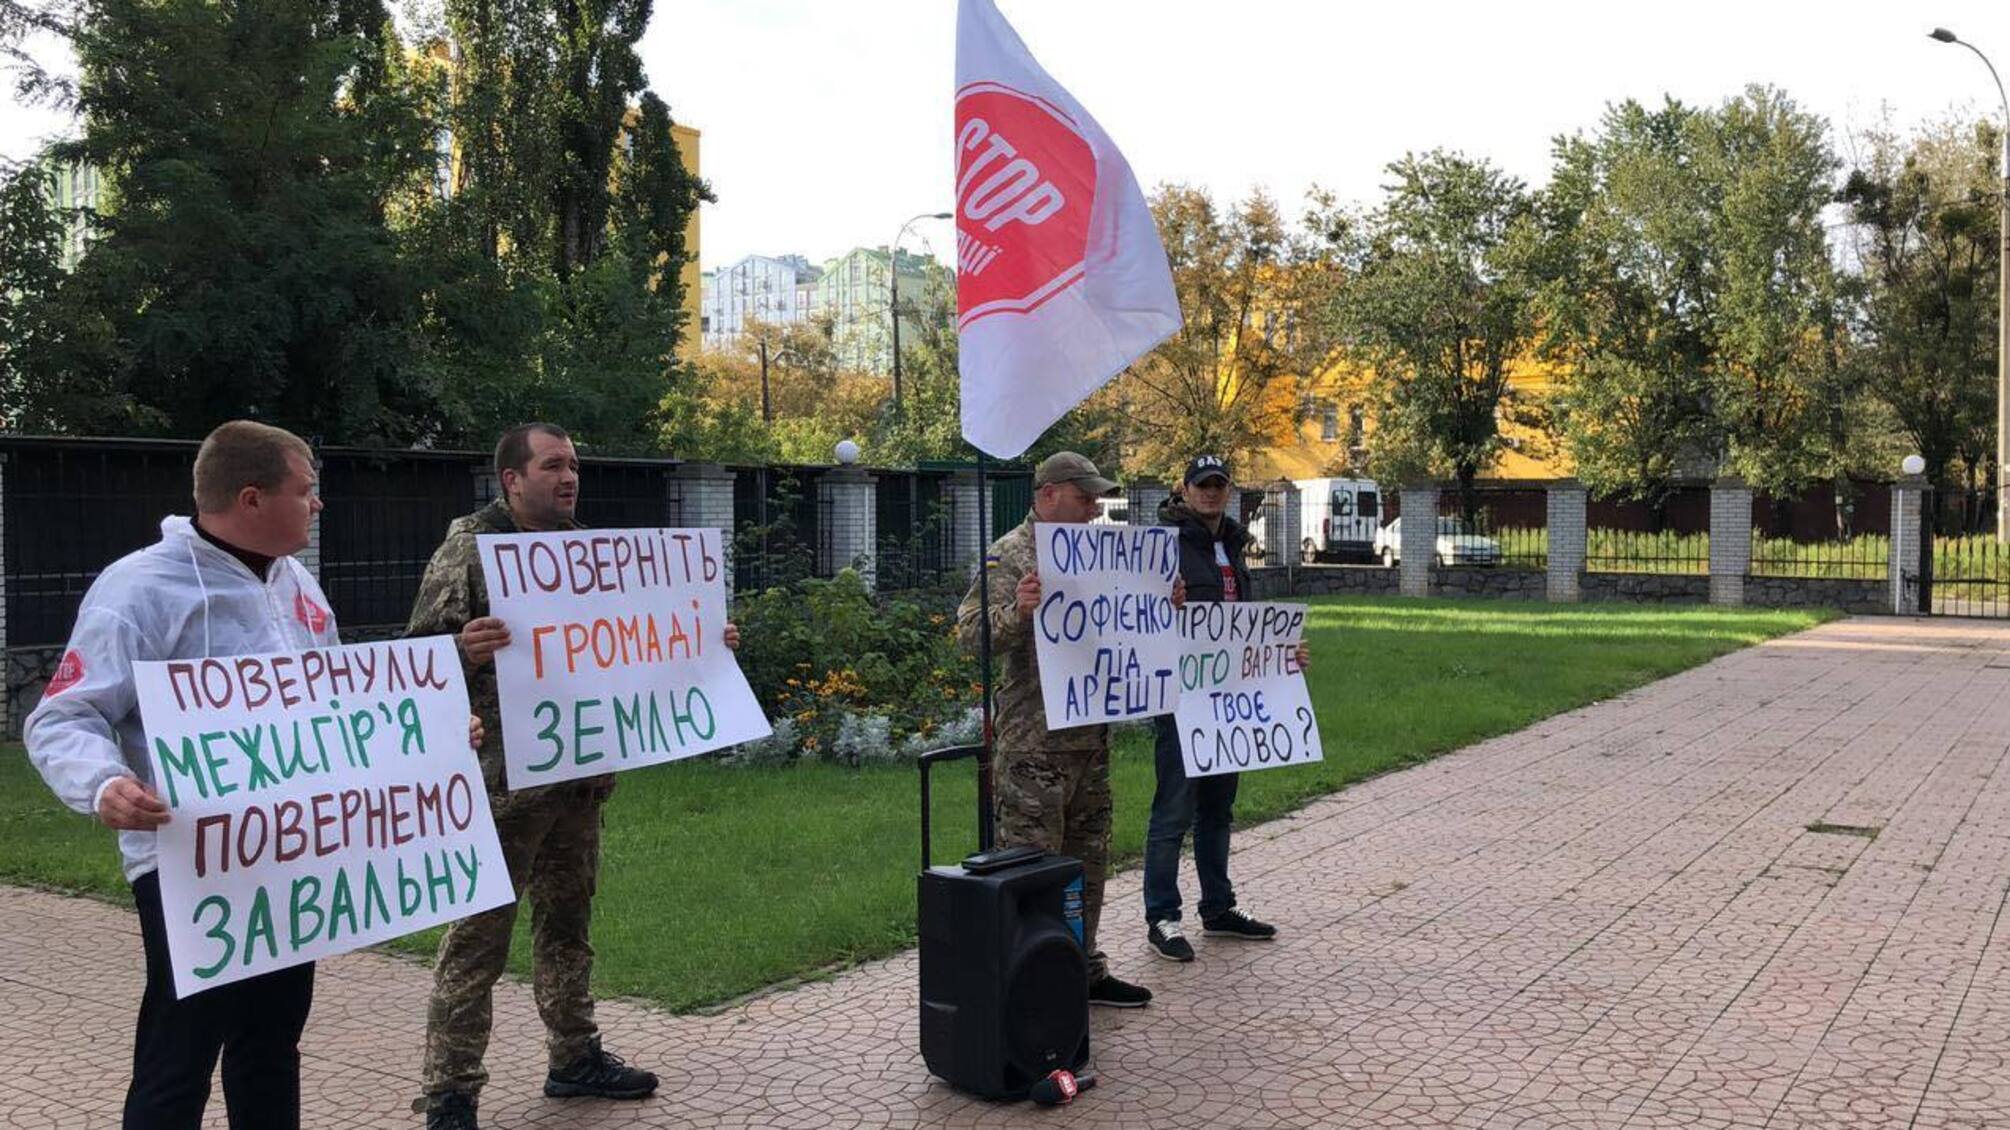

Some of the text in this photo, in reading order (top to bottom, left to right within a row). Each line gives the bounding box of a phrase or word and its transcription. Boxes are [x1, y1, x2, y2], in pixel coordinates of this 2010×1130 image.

[494, 530, 717, 597] ПОВЕРНІТЬ
[532, 600, 701, 680] ГРОМАДІ
[1041, 587, 1172, 644] СОФІЄНКО
[1177, 602, 1303, 641] ПРОКУРОР
[167, 646, 448, 712] ПОВЕРНУЛИ
[1095, 642, 1141, 679] ПІД
[1242, 644, 1300, 680] ВАРТЕ
[1066, 669, 1173, 721] АРЕШТ
[1210, 690, 1271, 723] ТВОЄ
[527, 686, 716, 772] ЗЕМЛЮ
[195, 773, 473, 878] ПОВЕРНЕМО
[192, 844, 479, 979] ЗАВАЛЬНУ
